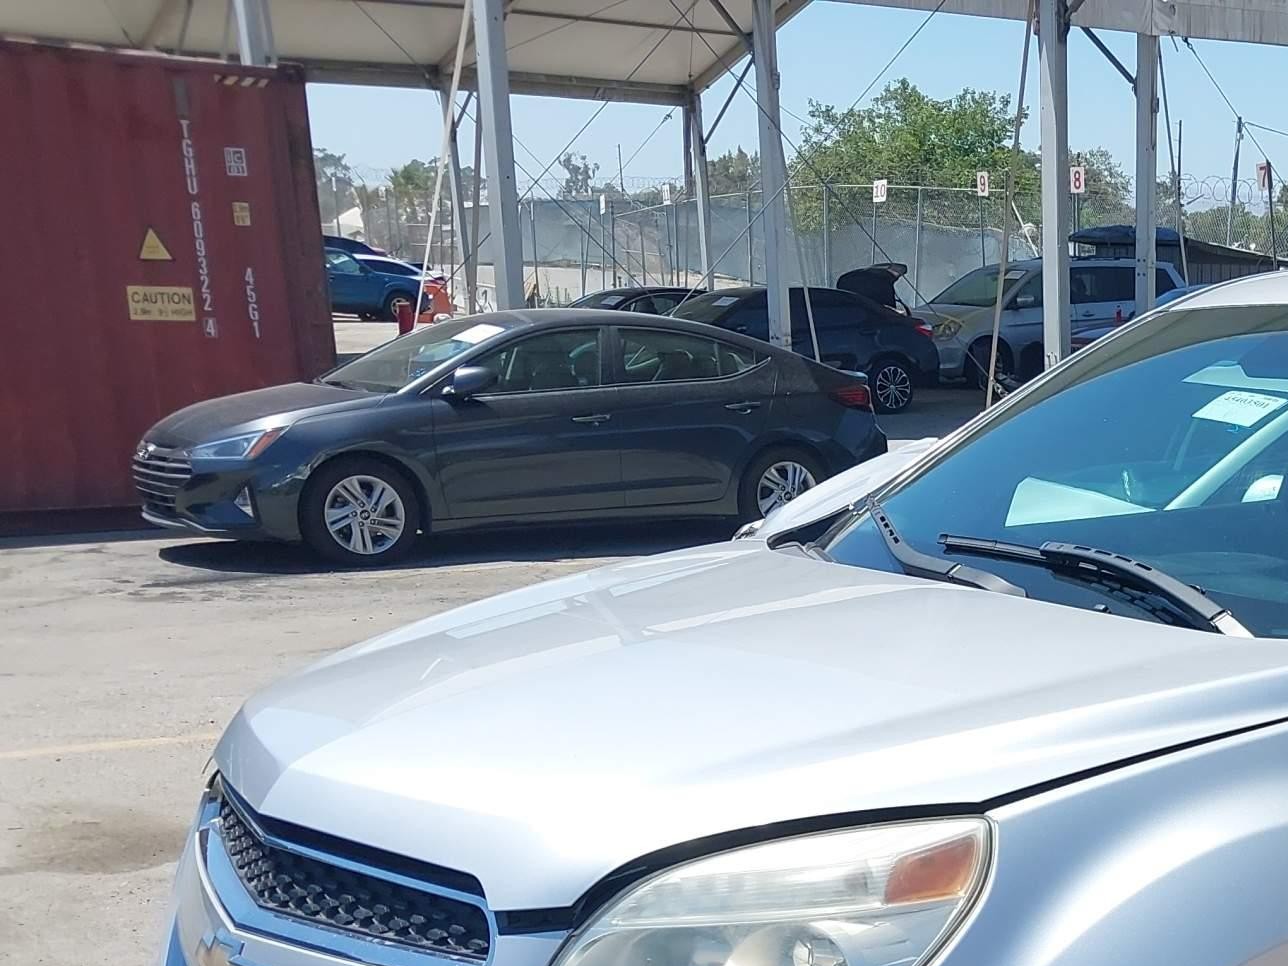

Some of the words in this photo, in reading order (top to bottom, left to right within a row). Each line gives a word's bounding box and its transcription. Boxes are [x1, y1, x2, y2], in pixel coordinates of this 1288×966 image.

[978, 175, 986, 192] 9
[1072, 170, 1082, 190] 8
[1259, 166, 1267, 188] 7
[873, 183, 887, 199] 10
[179, 119, 198, 195] TGHU
[192, 201, 213, 311] 609322
[205, 319, 217, 337] 4
[130, 291, 192, 305] CAUTION
[244, 267, 260, 339] 45G1
